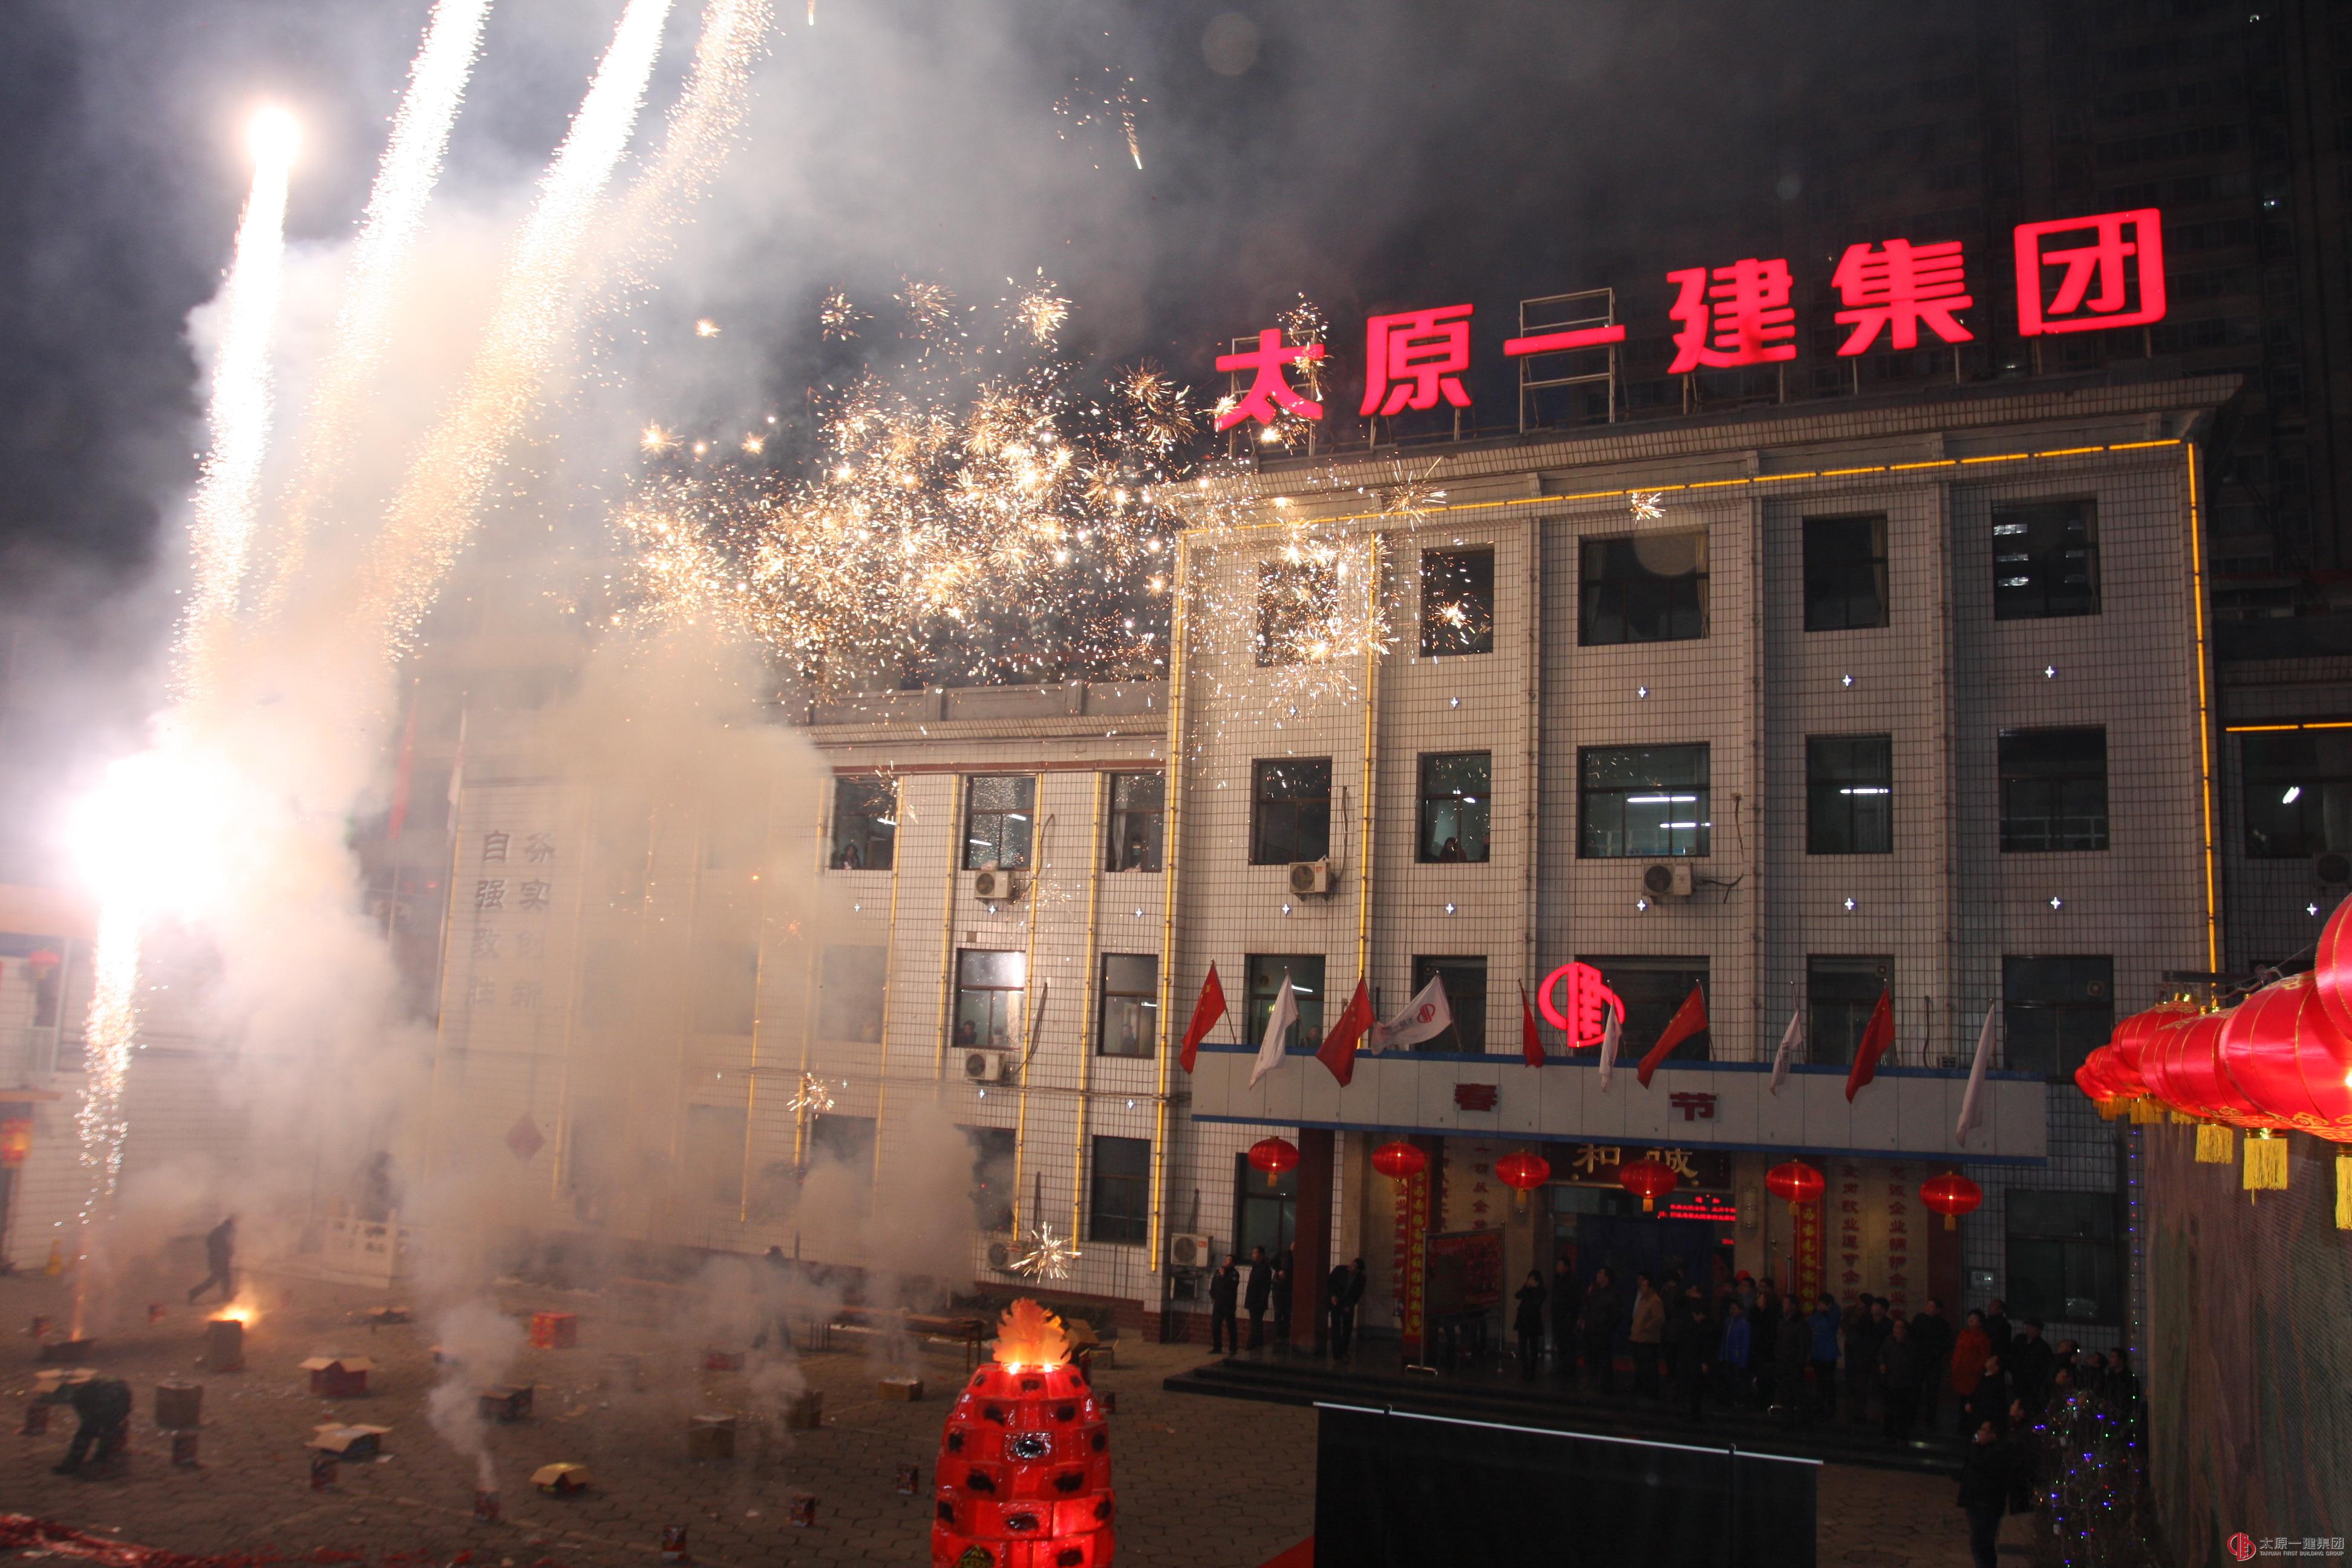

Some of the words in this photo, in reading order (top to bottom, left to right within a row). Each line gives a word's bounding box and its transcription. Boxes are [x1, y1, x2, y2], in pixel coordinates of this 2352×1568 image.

[1215, 207, 2167, 431] 太原一建集团
